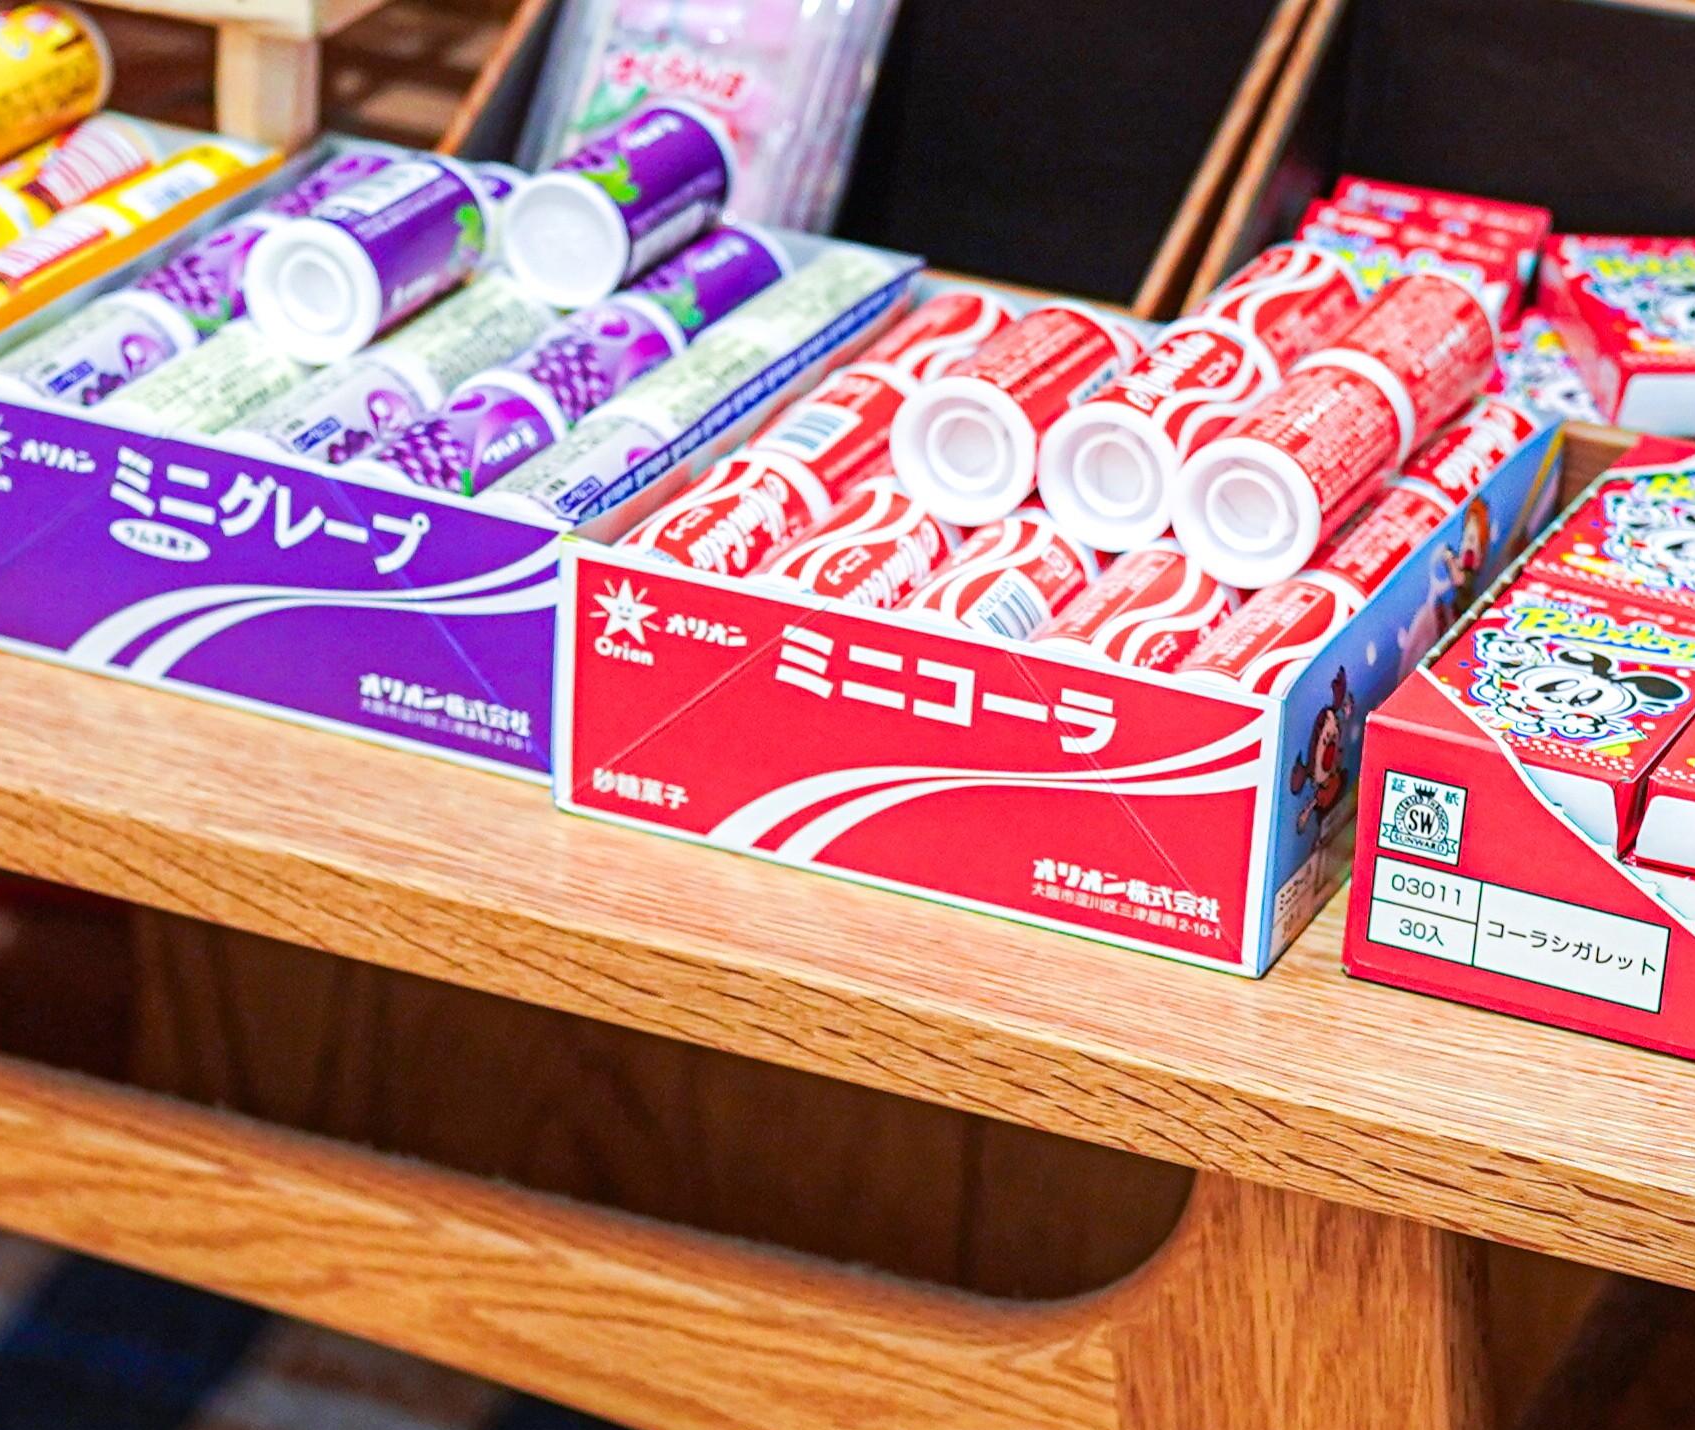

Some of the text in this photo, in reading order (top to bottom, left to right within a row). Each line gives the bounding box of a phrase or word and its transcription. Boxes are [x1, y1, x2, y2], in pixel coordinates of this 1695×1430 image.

[20, 438, 97, 474] オリオン
[109, 445, 431, 574] ミニグレープ
[665, 613, 748, 647] オリオン
[594, 636, 655, 667] Orion
[359, 672, 531, 738] オリオン株式会社
[775, 625, 1118, 755] ミニコーラ
[592, 767, 690, 810] 砂糖菓子
[1407, 807, 1436, 836] SW
[1392, 832, 1446, 854] SUNWARD
[1032, 857, 1221, 923] オリオン株式会社
[1391, 873, 1463, 907] 03011
[1399, 918, 1445, 947] 30入
[1487, 920, 1657, 977] コーラシガレット
